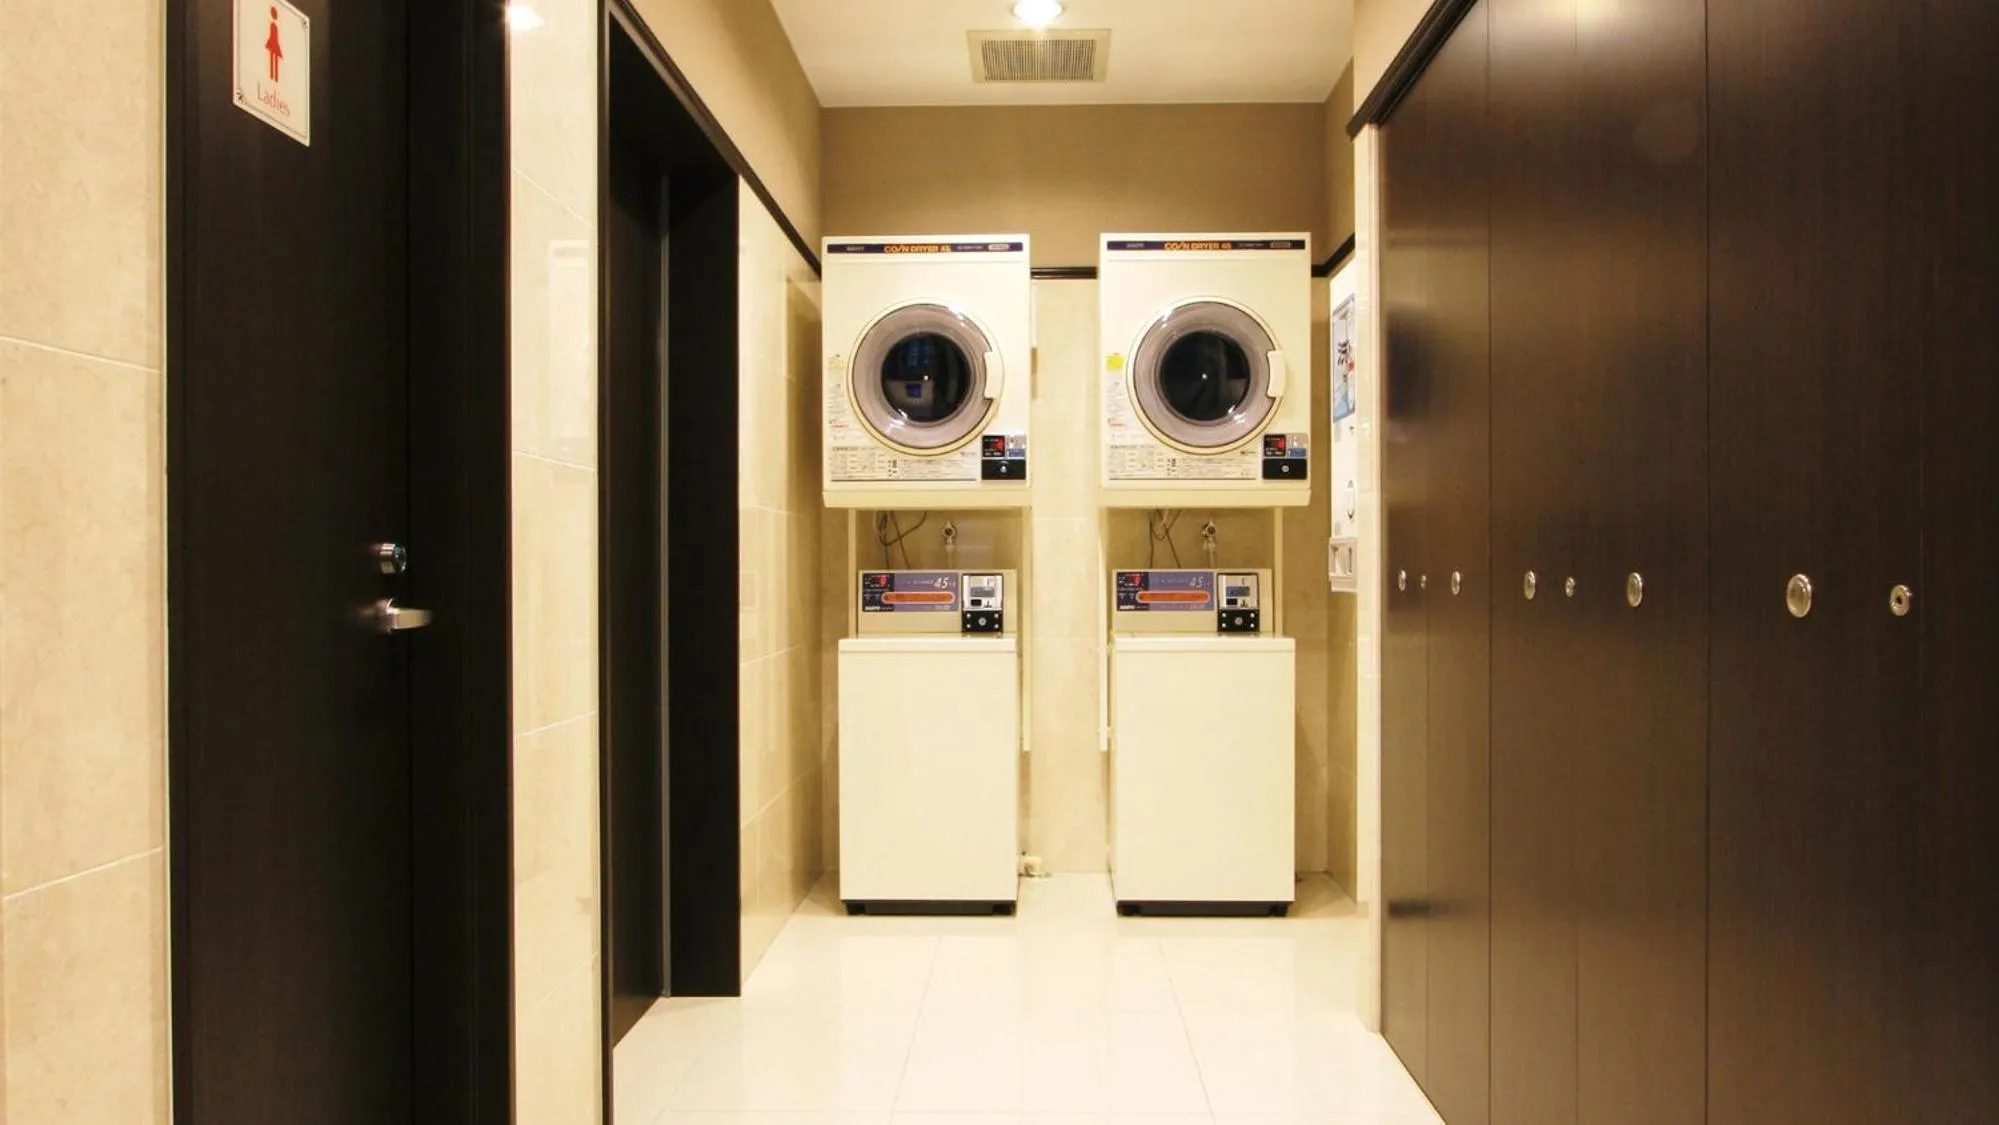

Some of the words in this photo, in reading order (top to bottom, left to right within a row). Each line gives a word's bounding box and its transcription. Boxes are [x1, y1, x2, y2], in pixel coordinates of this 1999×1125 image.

[257, 82, 290, 116] Ladies
[934, 577, 950, 589] 45
[1189, 576, 1205, 588] 45
